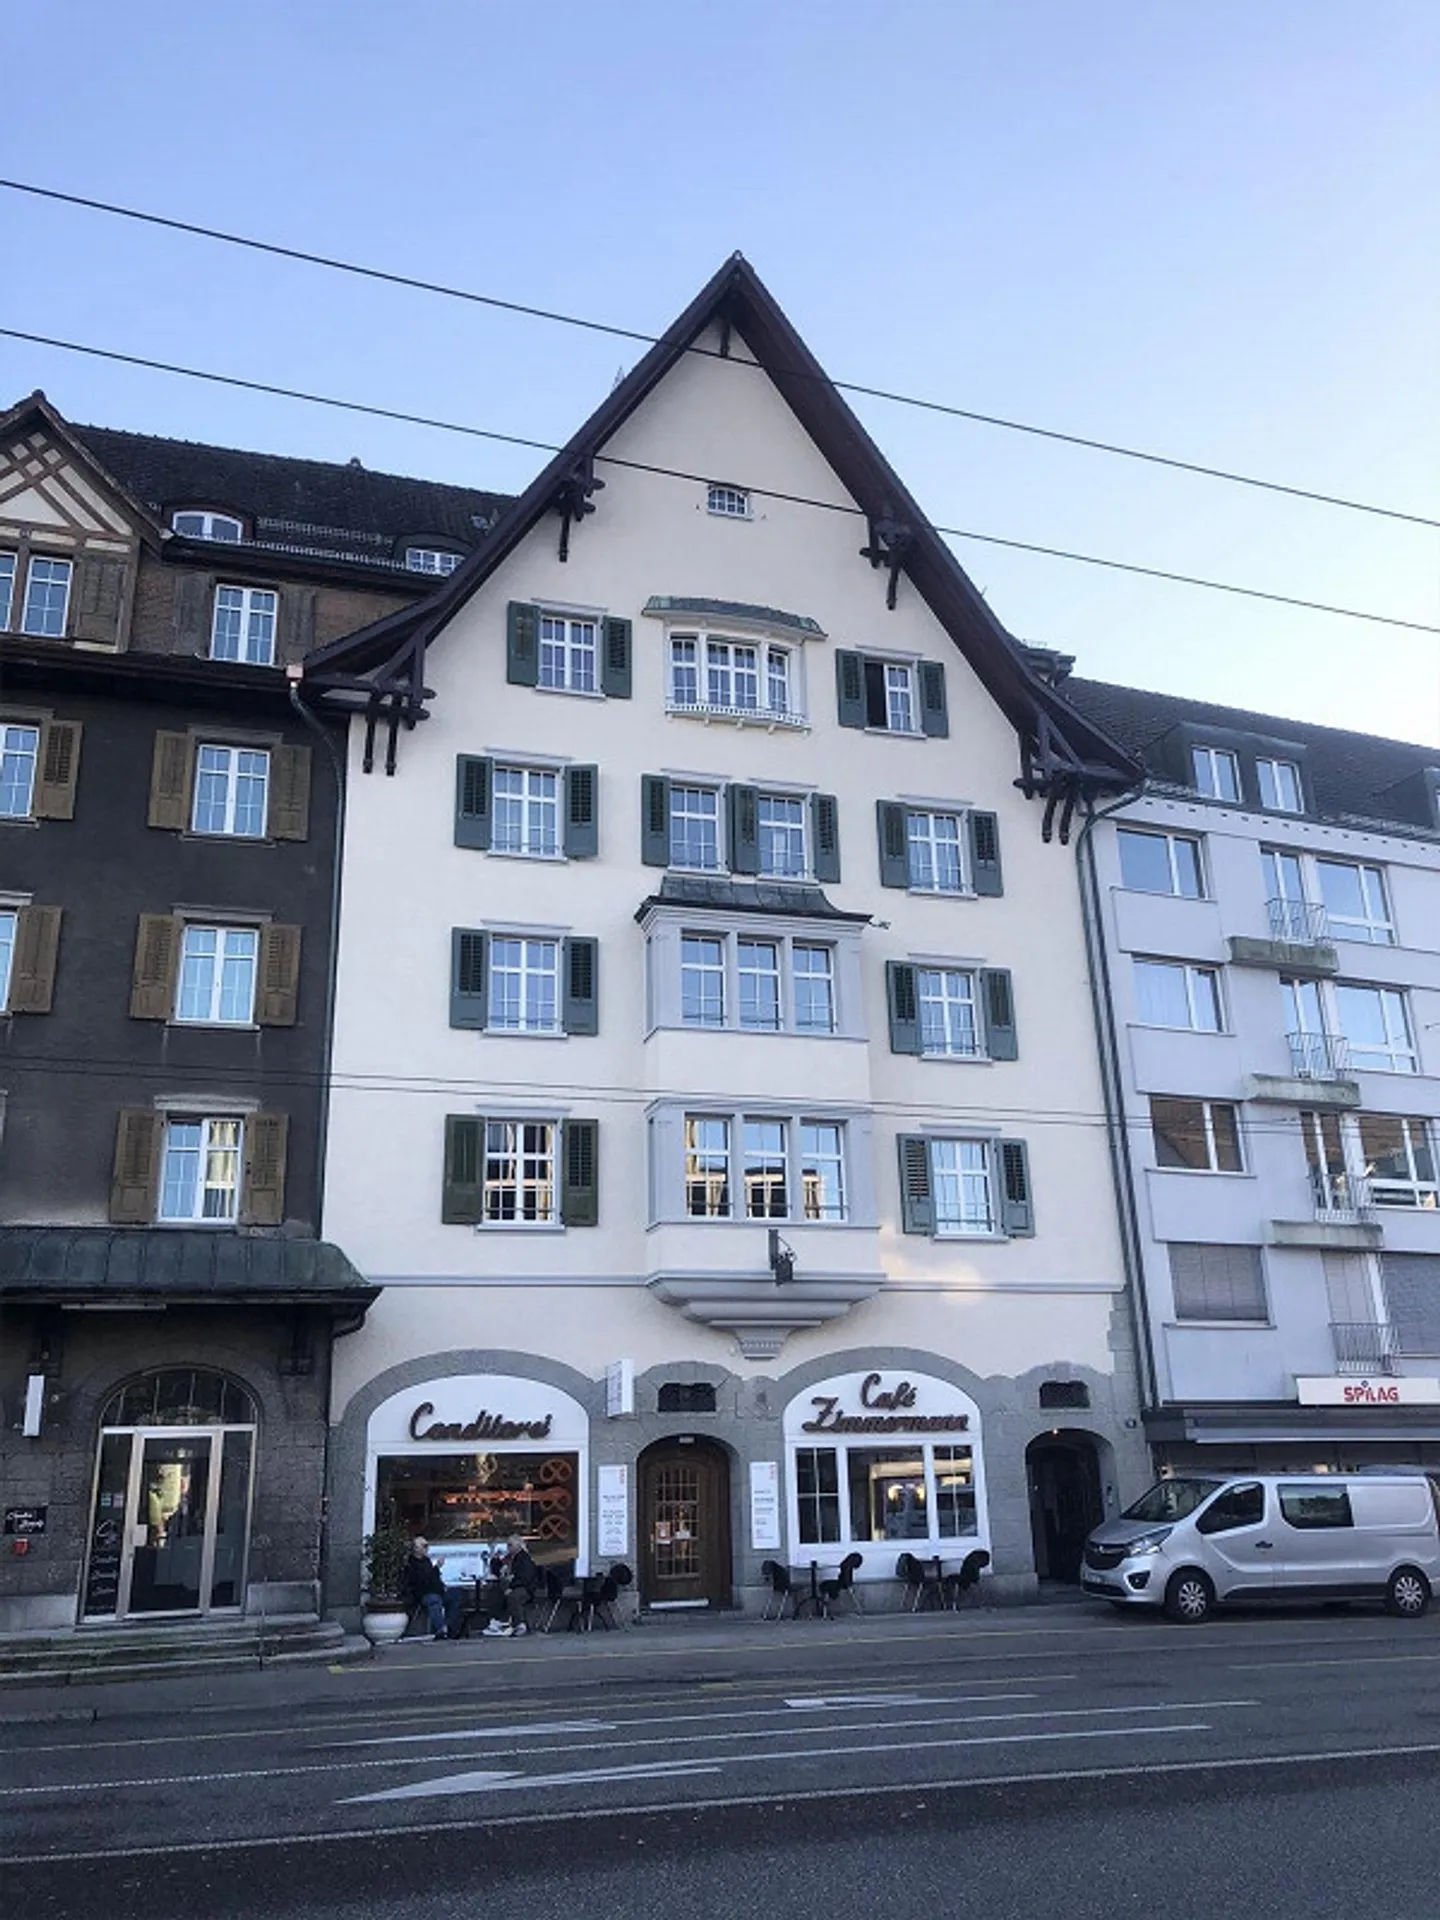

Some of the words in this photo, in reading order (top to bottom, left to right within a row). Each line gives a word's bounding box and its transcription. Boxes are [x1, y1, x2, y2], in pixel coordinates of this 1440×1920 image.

[860, 1373, 917, 1410] Café
[1344, 1386, 1398, 1402] SPILAG
[410, 1401, 552, 1440] Conditorei
[802, 1396, 969, 1433] Zimmermann
